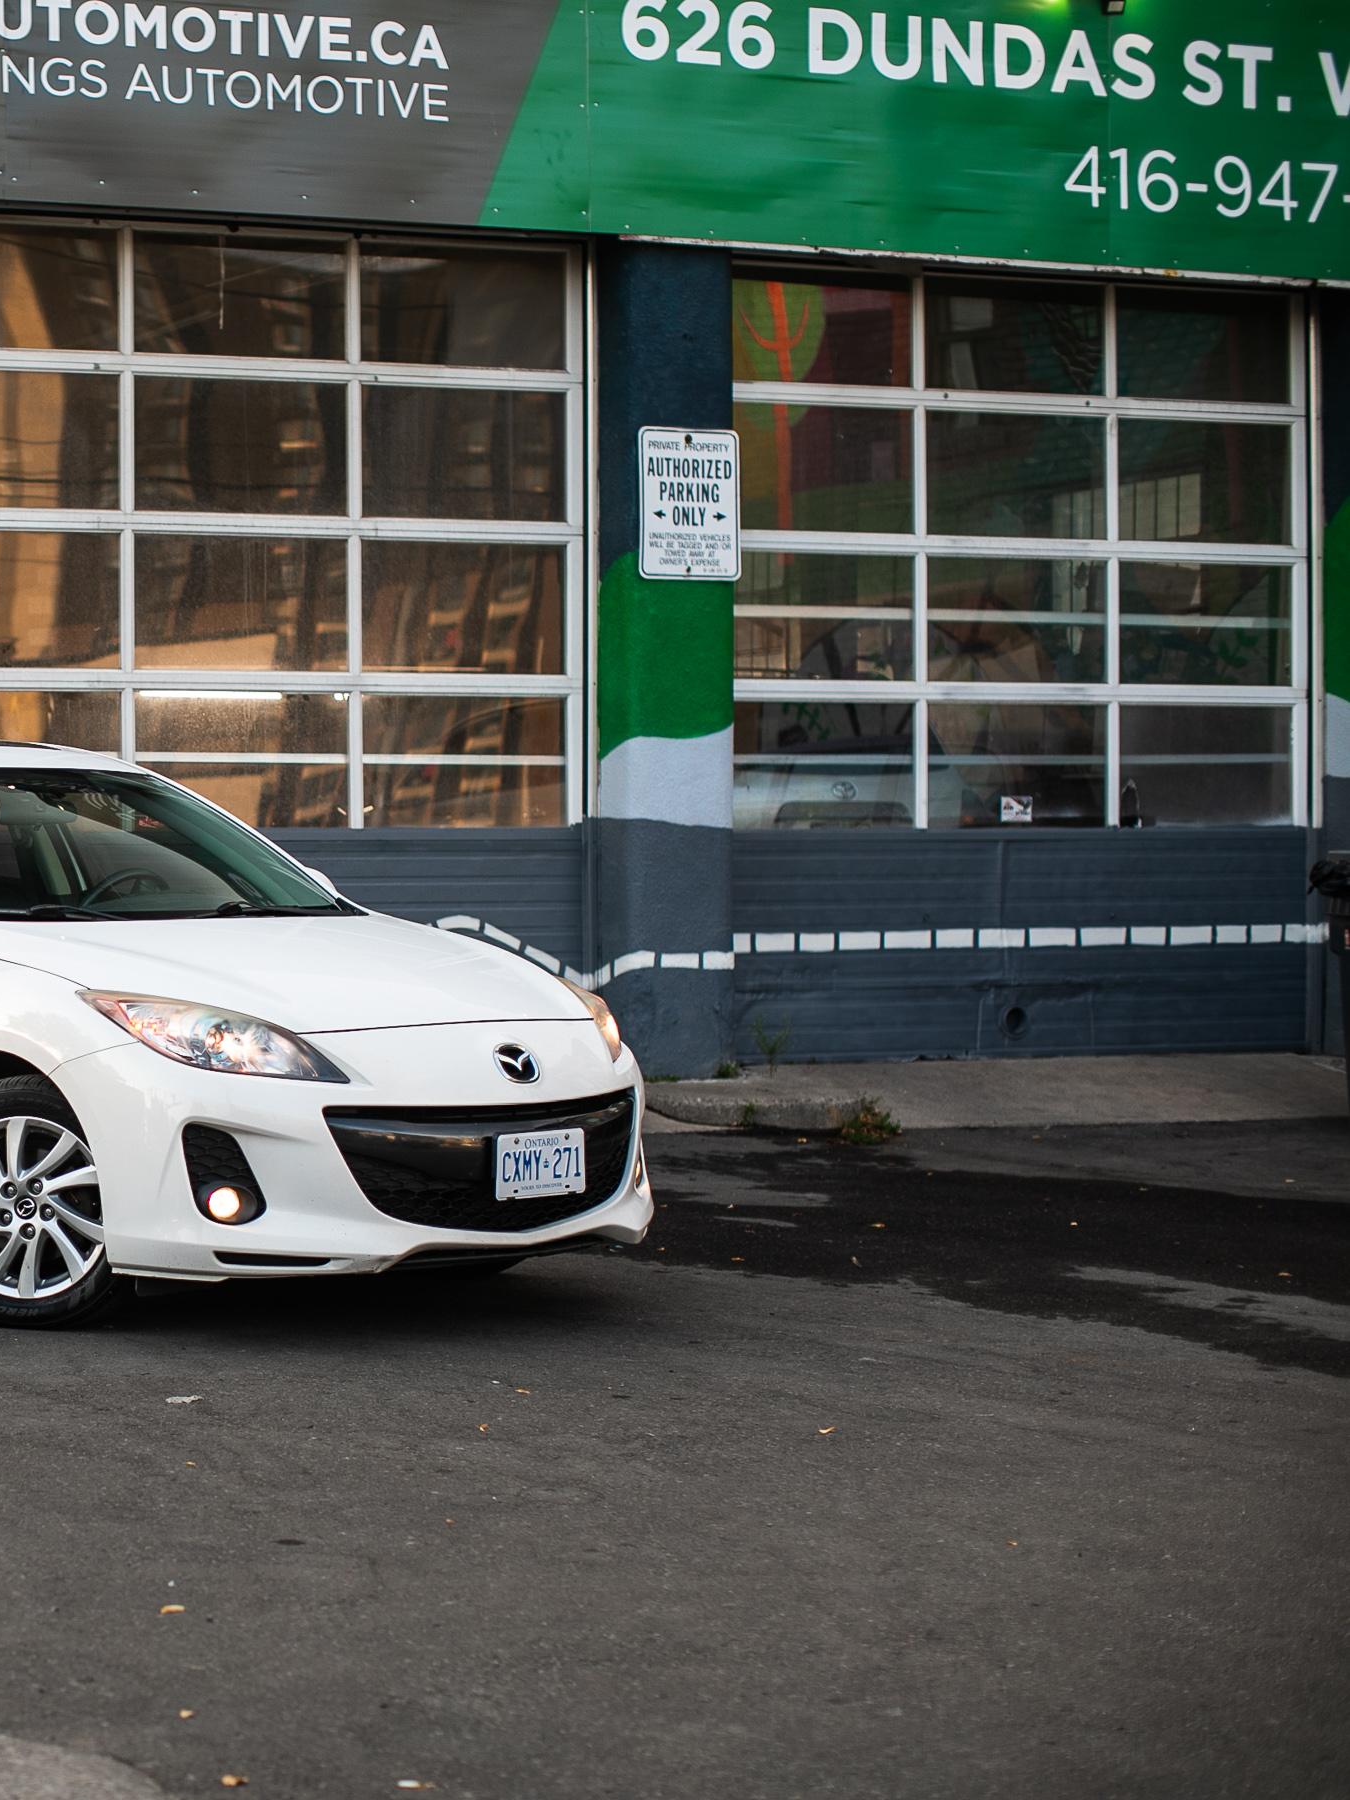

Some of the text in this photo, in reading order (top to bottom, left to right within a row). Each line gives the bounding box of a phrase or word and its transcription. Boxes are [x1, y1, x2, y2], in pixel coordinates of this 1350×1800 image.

[622, 0, 776, 69] 626
[808, 7, 1156, 100] DUNDAS
[1182, 40, 1291, 112] ST.
[125, 63, 449, 122] AUTOMOTIVE
[648, 440, 730, 453] PRIVATE PROPERTY
[647, 456, 732, 480] AUTHORIZED
[659, 481, 720, 503] PARKING
[672, 506, 706, 527] ONLY
[524, 1137, 559, 1149] ONTARIO
[502, 1146, 581, 1183] CXMY 271
